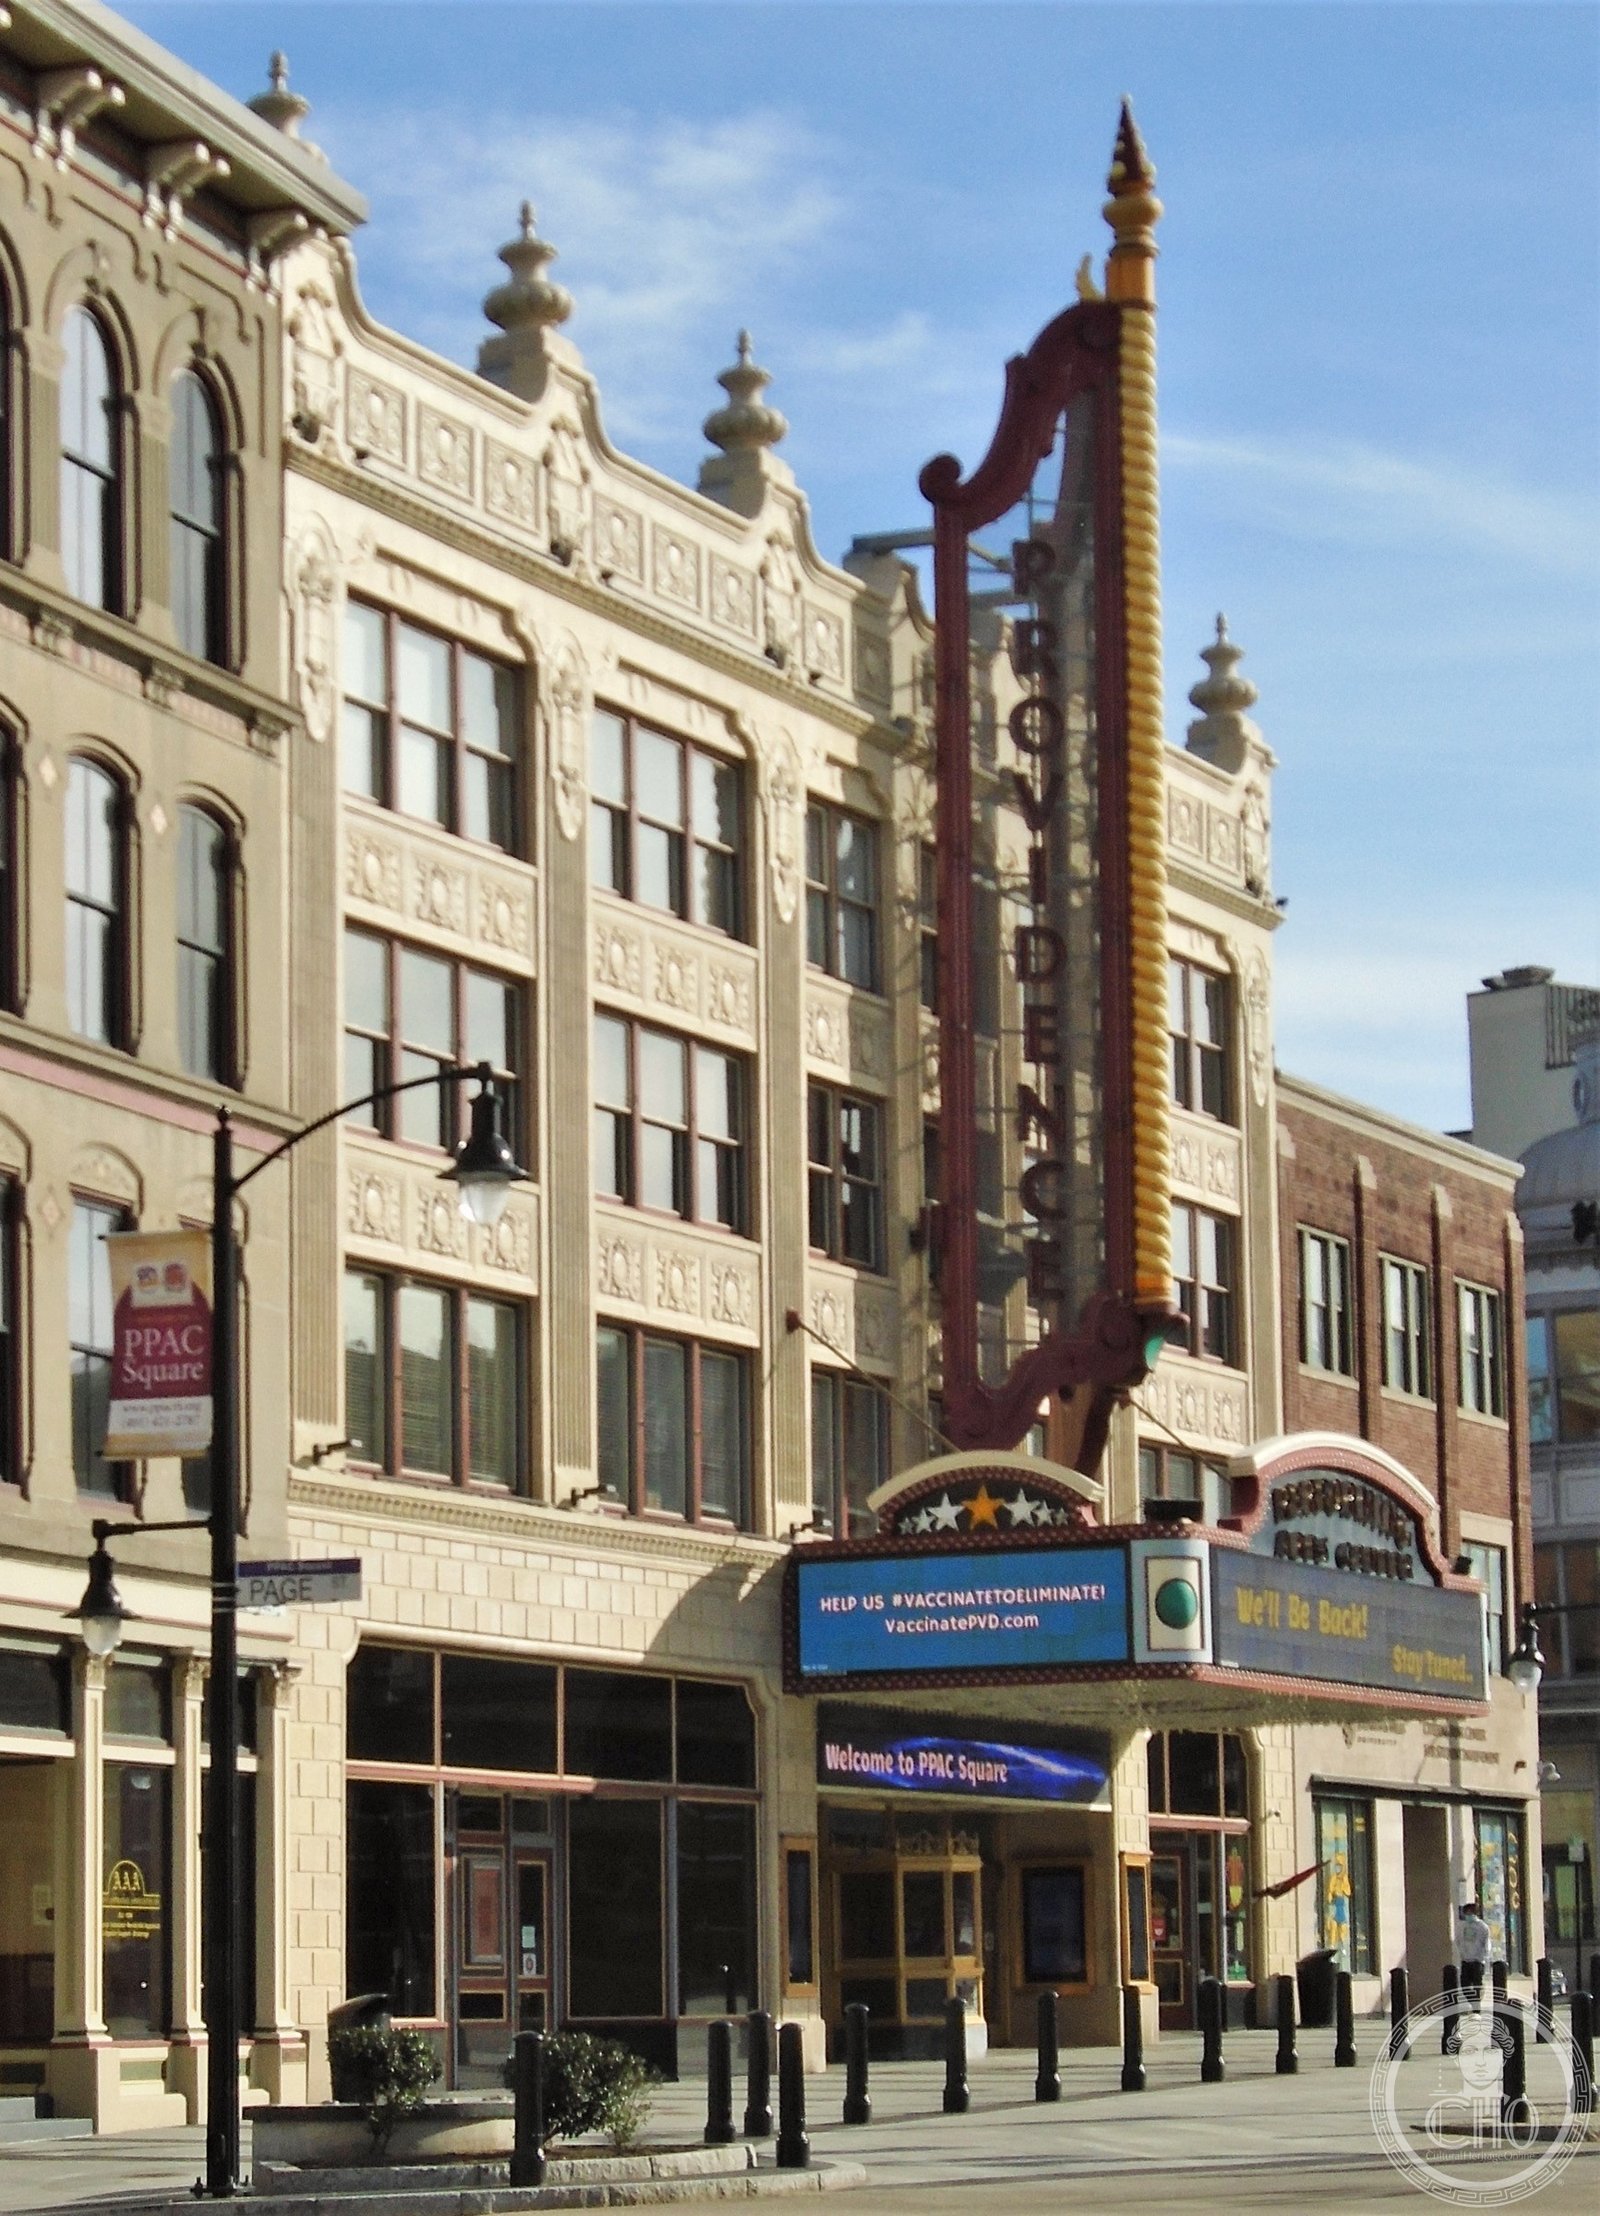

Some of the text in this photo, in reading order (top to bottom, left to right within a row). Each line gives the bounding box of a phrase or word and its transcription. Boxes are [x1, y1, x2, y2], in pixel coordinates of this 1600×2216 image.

[1008, 539, 1065, 1301] PROVIDENCE
[124, 1324, 204, 1357] PPAC
[121, 1359, 204, 1390] Square
[249, 1578, 314, 1604] PAGE
[820, 1584, 1106, 1612] HELP US #VACCINATETOELIMINATE!
[885, 1614, 1039, 1633] VaccinatePVD.com
[1236, 1586, 1369, 1639] We'll Be Back!
[825, 1743, 1008, 1787] Welcome to PPAC Square
[112, 1871, 141, 1891] AAA
